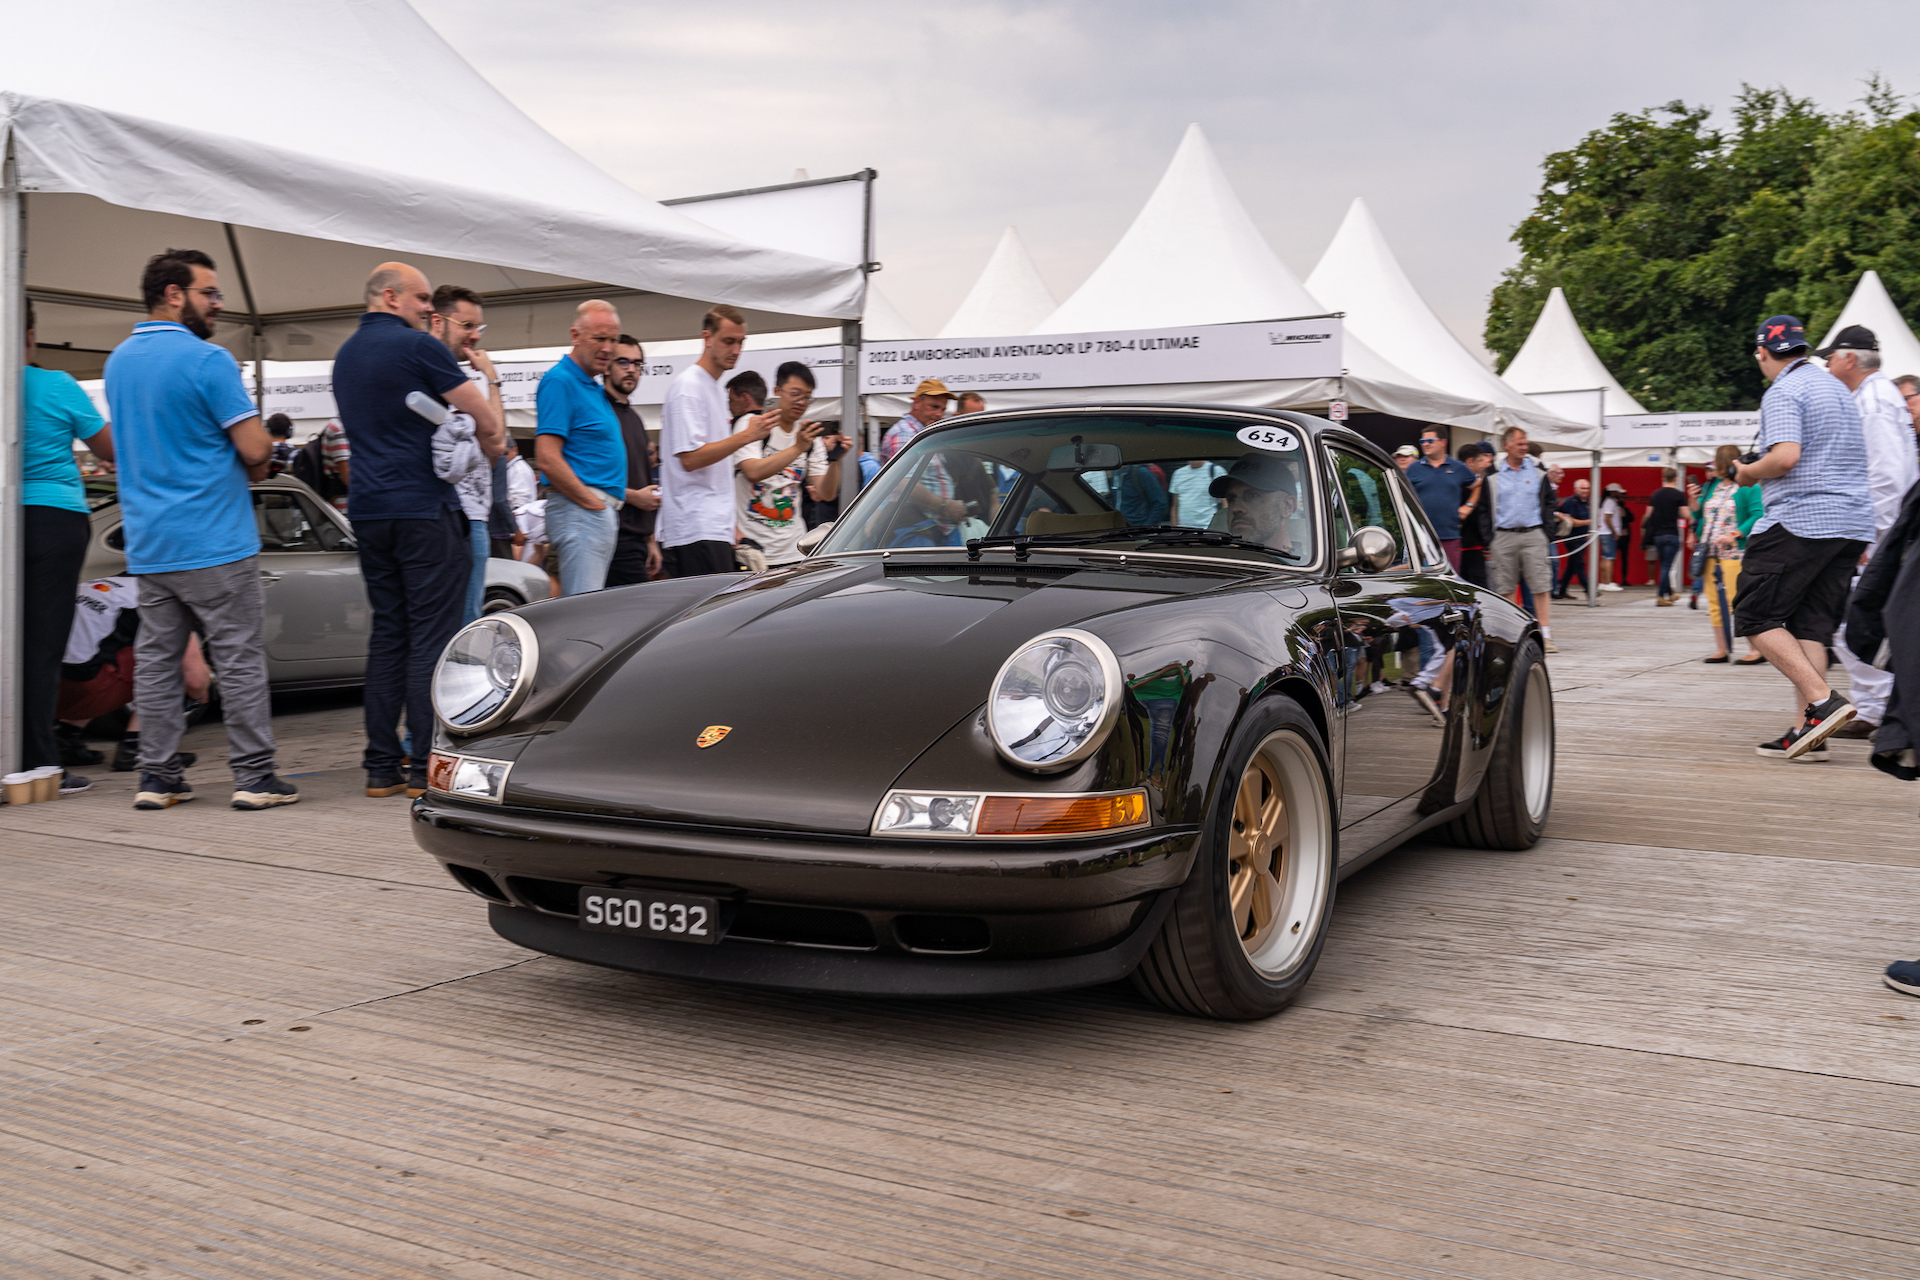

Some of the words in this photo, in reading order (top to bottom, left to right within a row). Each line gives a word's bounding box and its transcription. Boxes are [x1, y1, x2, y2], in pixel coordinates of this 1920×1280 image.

[868, 351, 898, 363] 2022
[901, 346, 991, 361] LAMBORGHINI
[992, 343, 1075, 358] AVENTADOR
[1078, 341, 1093, 354] LP
[1096, 340, 1135, 352] 780-4
[1139, 336, 1200, 350] ULTIMAE
[652, 365, 673, 376] STO
[867, 375, 898, 386] Class
[1247, 430, 1290, 447] 654
[585, 895, 643, 929] SGO
[648, 901, 708, 937] 632
